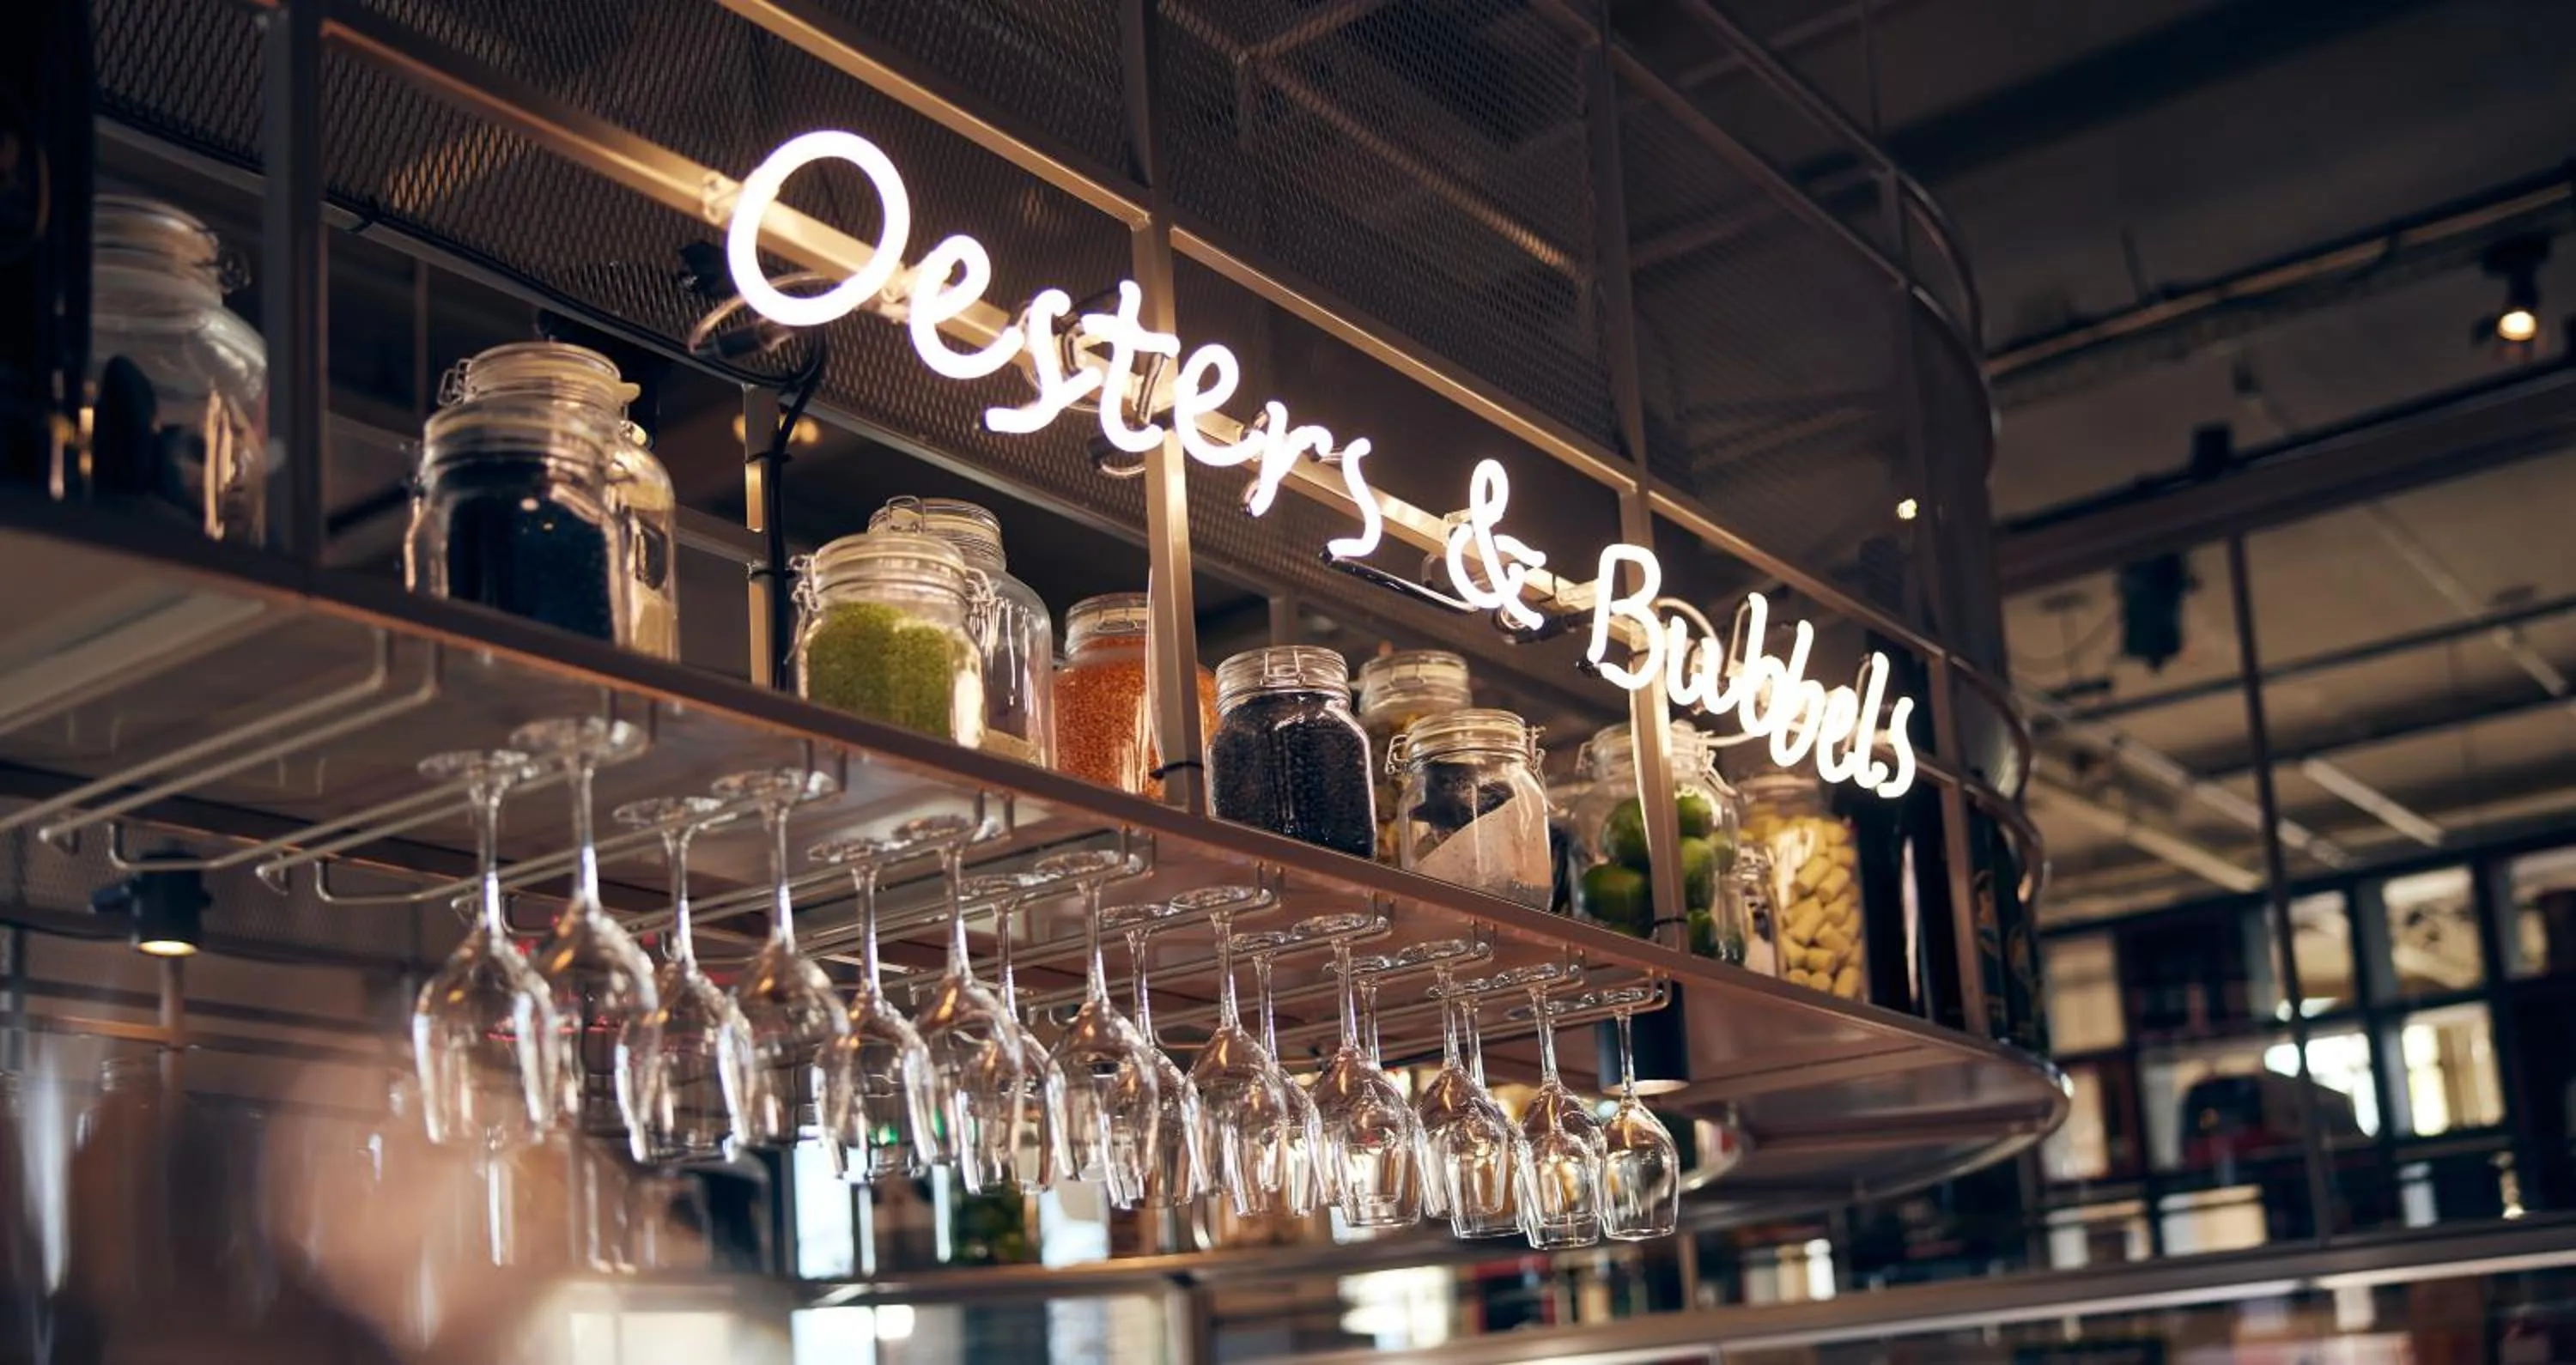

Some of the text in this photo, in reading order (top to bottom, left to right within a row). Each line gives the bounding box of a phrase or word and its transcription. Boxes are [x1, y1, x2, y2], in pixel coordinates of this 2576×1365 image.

[727, 129, 1916, 798] Oesters & Bubbels
